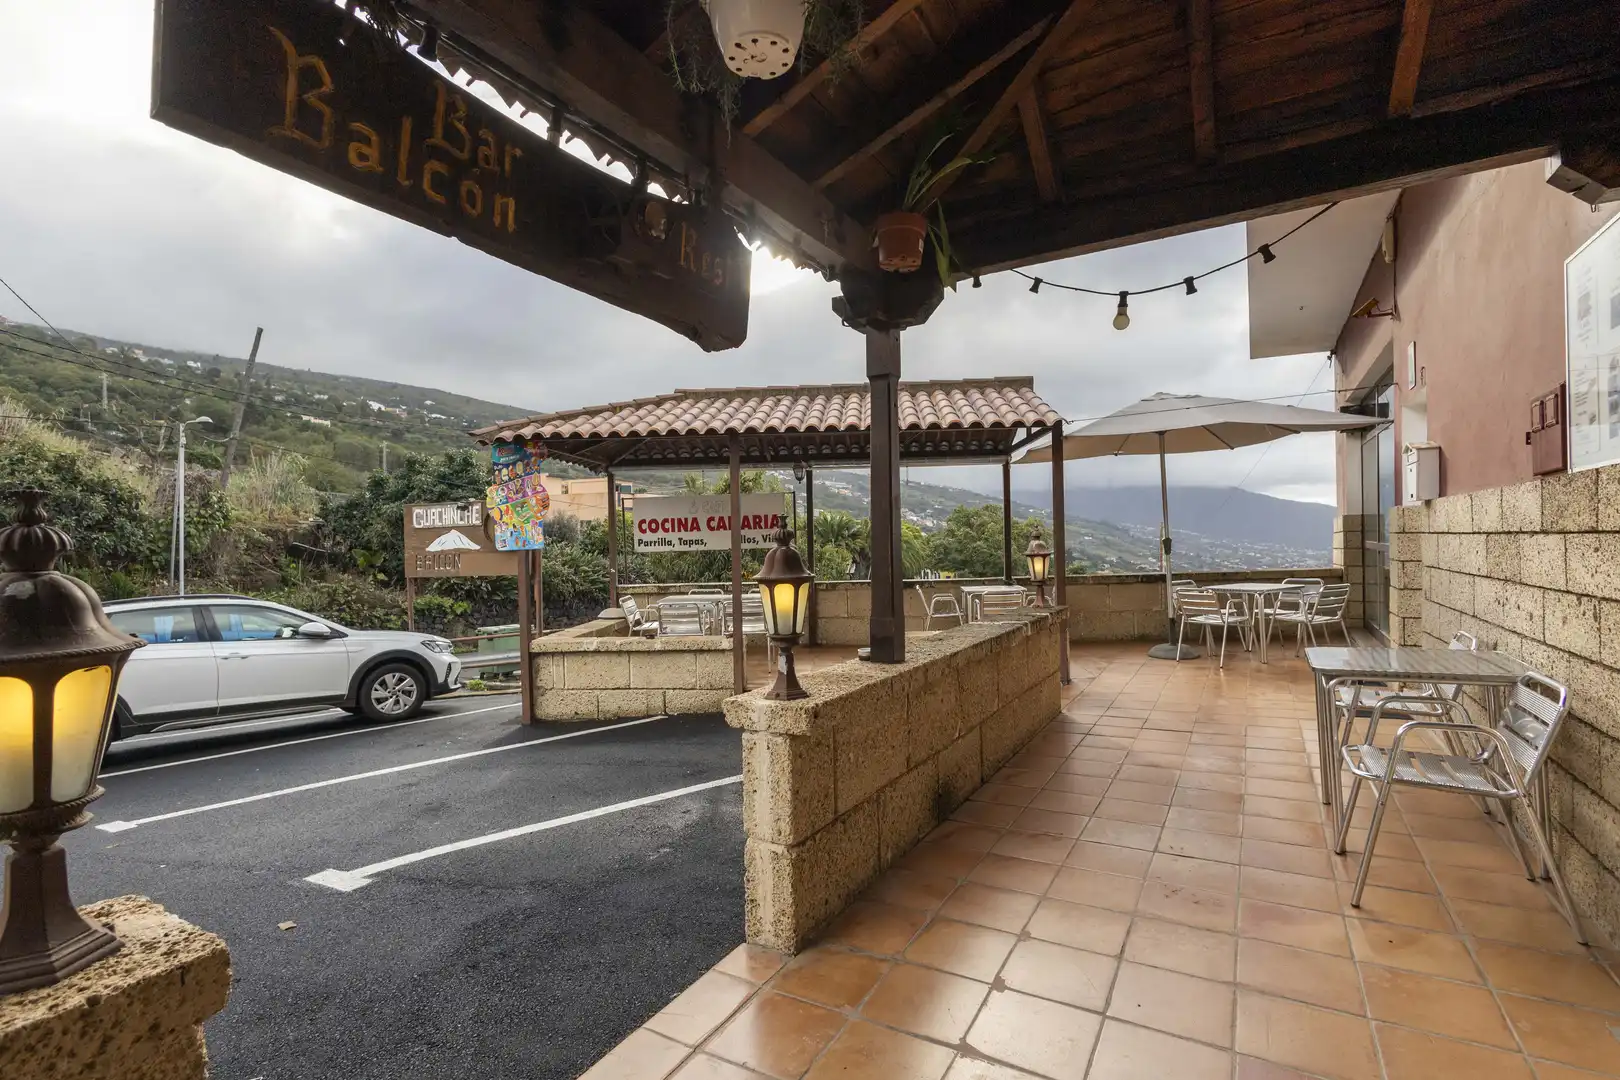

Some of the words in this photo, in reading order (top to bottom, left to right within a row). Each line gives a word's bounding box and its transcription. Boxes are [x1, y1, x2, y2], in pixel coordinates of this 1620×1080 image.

[424, 79, 525, 178] Bar
[637, 516, 702, 535] COCINA
[706, 514, 781, 532] CAARIA
[637, 537, 676, 549] Parrilla,
[678, 536, 708, 547] Tapas,
